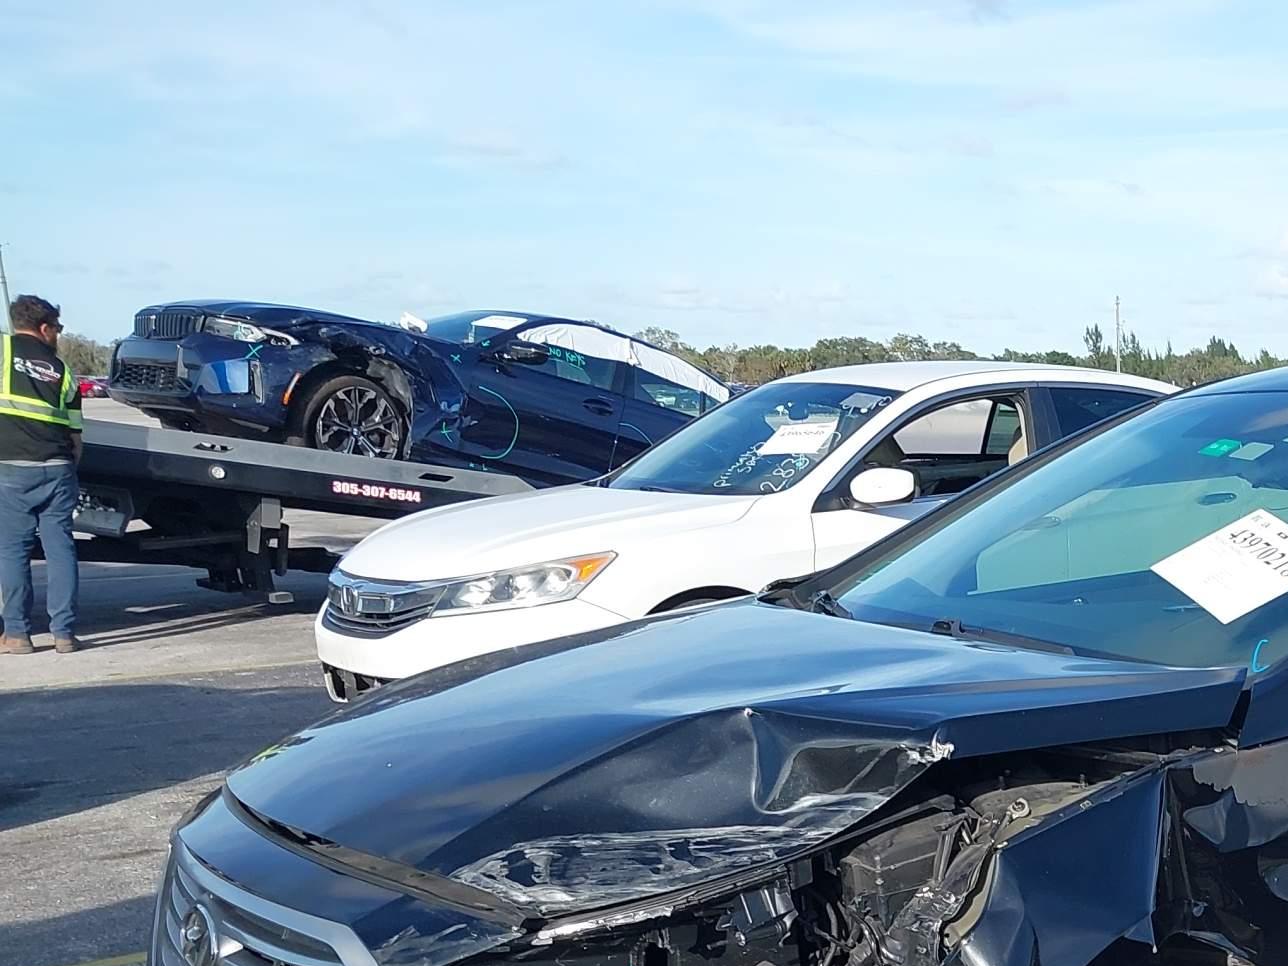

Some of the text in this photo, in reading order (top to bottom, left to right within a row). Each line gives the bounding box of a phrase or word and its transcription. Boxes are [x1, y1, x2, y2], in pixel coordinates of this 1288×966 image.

[549, 346, 586, 367] NO KEYS
[332, 480, 421, 503] 305-307-6544
